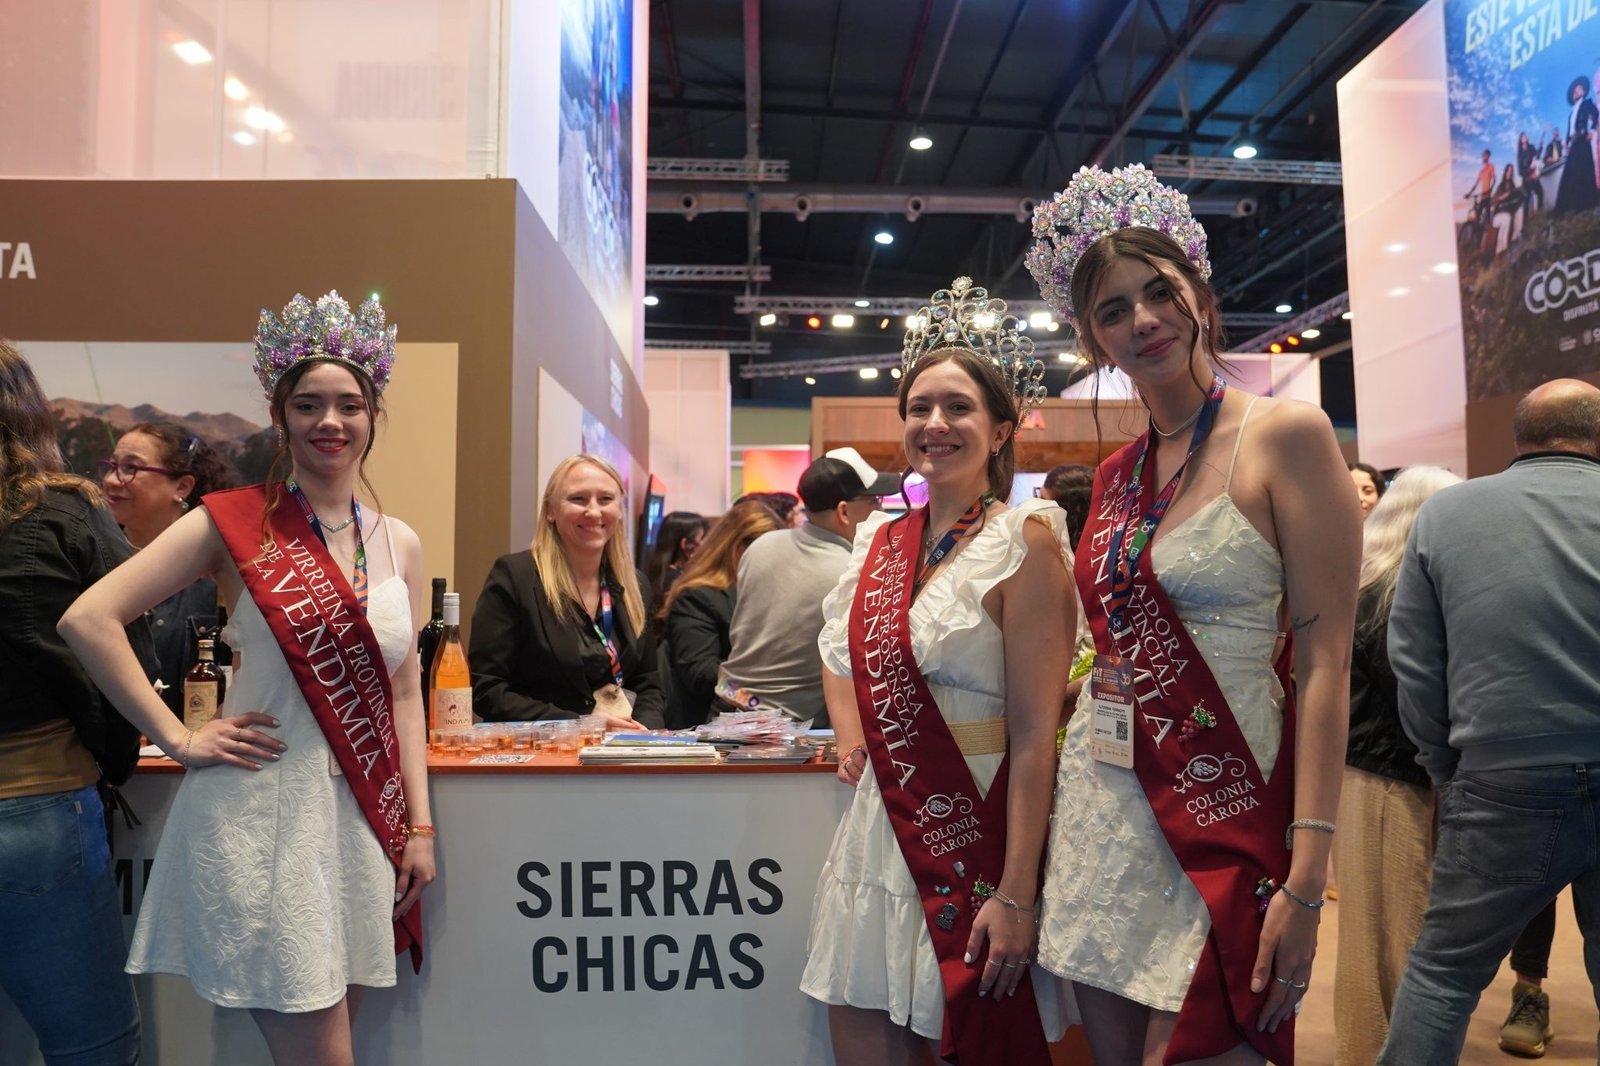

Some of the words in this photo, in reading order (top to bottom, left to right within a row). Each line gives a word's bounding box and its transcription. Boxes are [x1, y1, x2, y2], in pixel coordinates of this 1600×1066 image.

[1510, 0, 1562, 71] ESTA
[259, 539, 284, 565] DE
[285, 537, 354, 640] VIRREINA
[345, 640, 395, 758] PROVINCIAL
[890, 558, 923, 717] EMBAJADORA
[253, 558, 272, 581] LA
[271, 569, 381, 781] VENDIMIA
[863, 558, 916, 791] VENDIMIA
[879, 612, 919, 745] PROVINCIAL
[1186, 779, 1256, 813] COLONIA
[1196, 796, 1260, 826] CAROYA
[923, 815, 980, 845] COLONIA
[930, 830, 983, 857] CAROYA
[516, 858, 784, 919] SIERRAS
[532, 932, 765, 993] CHICAS
